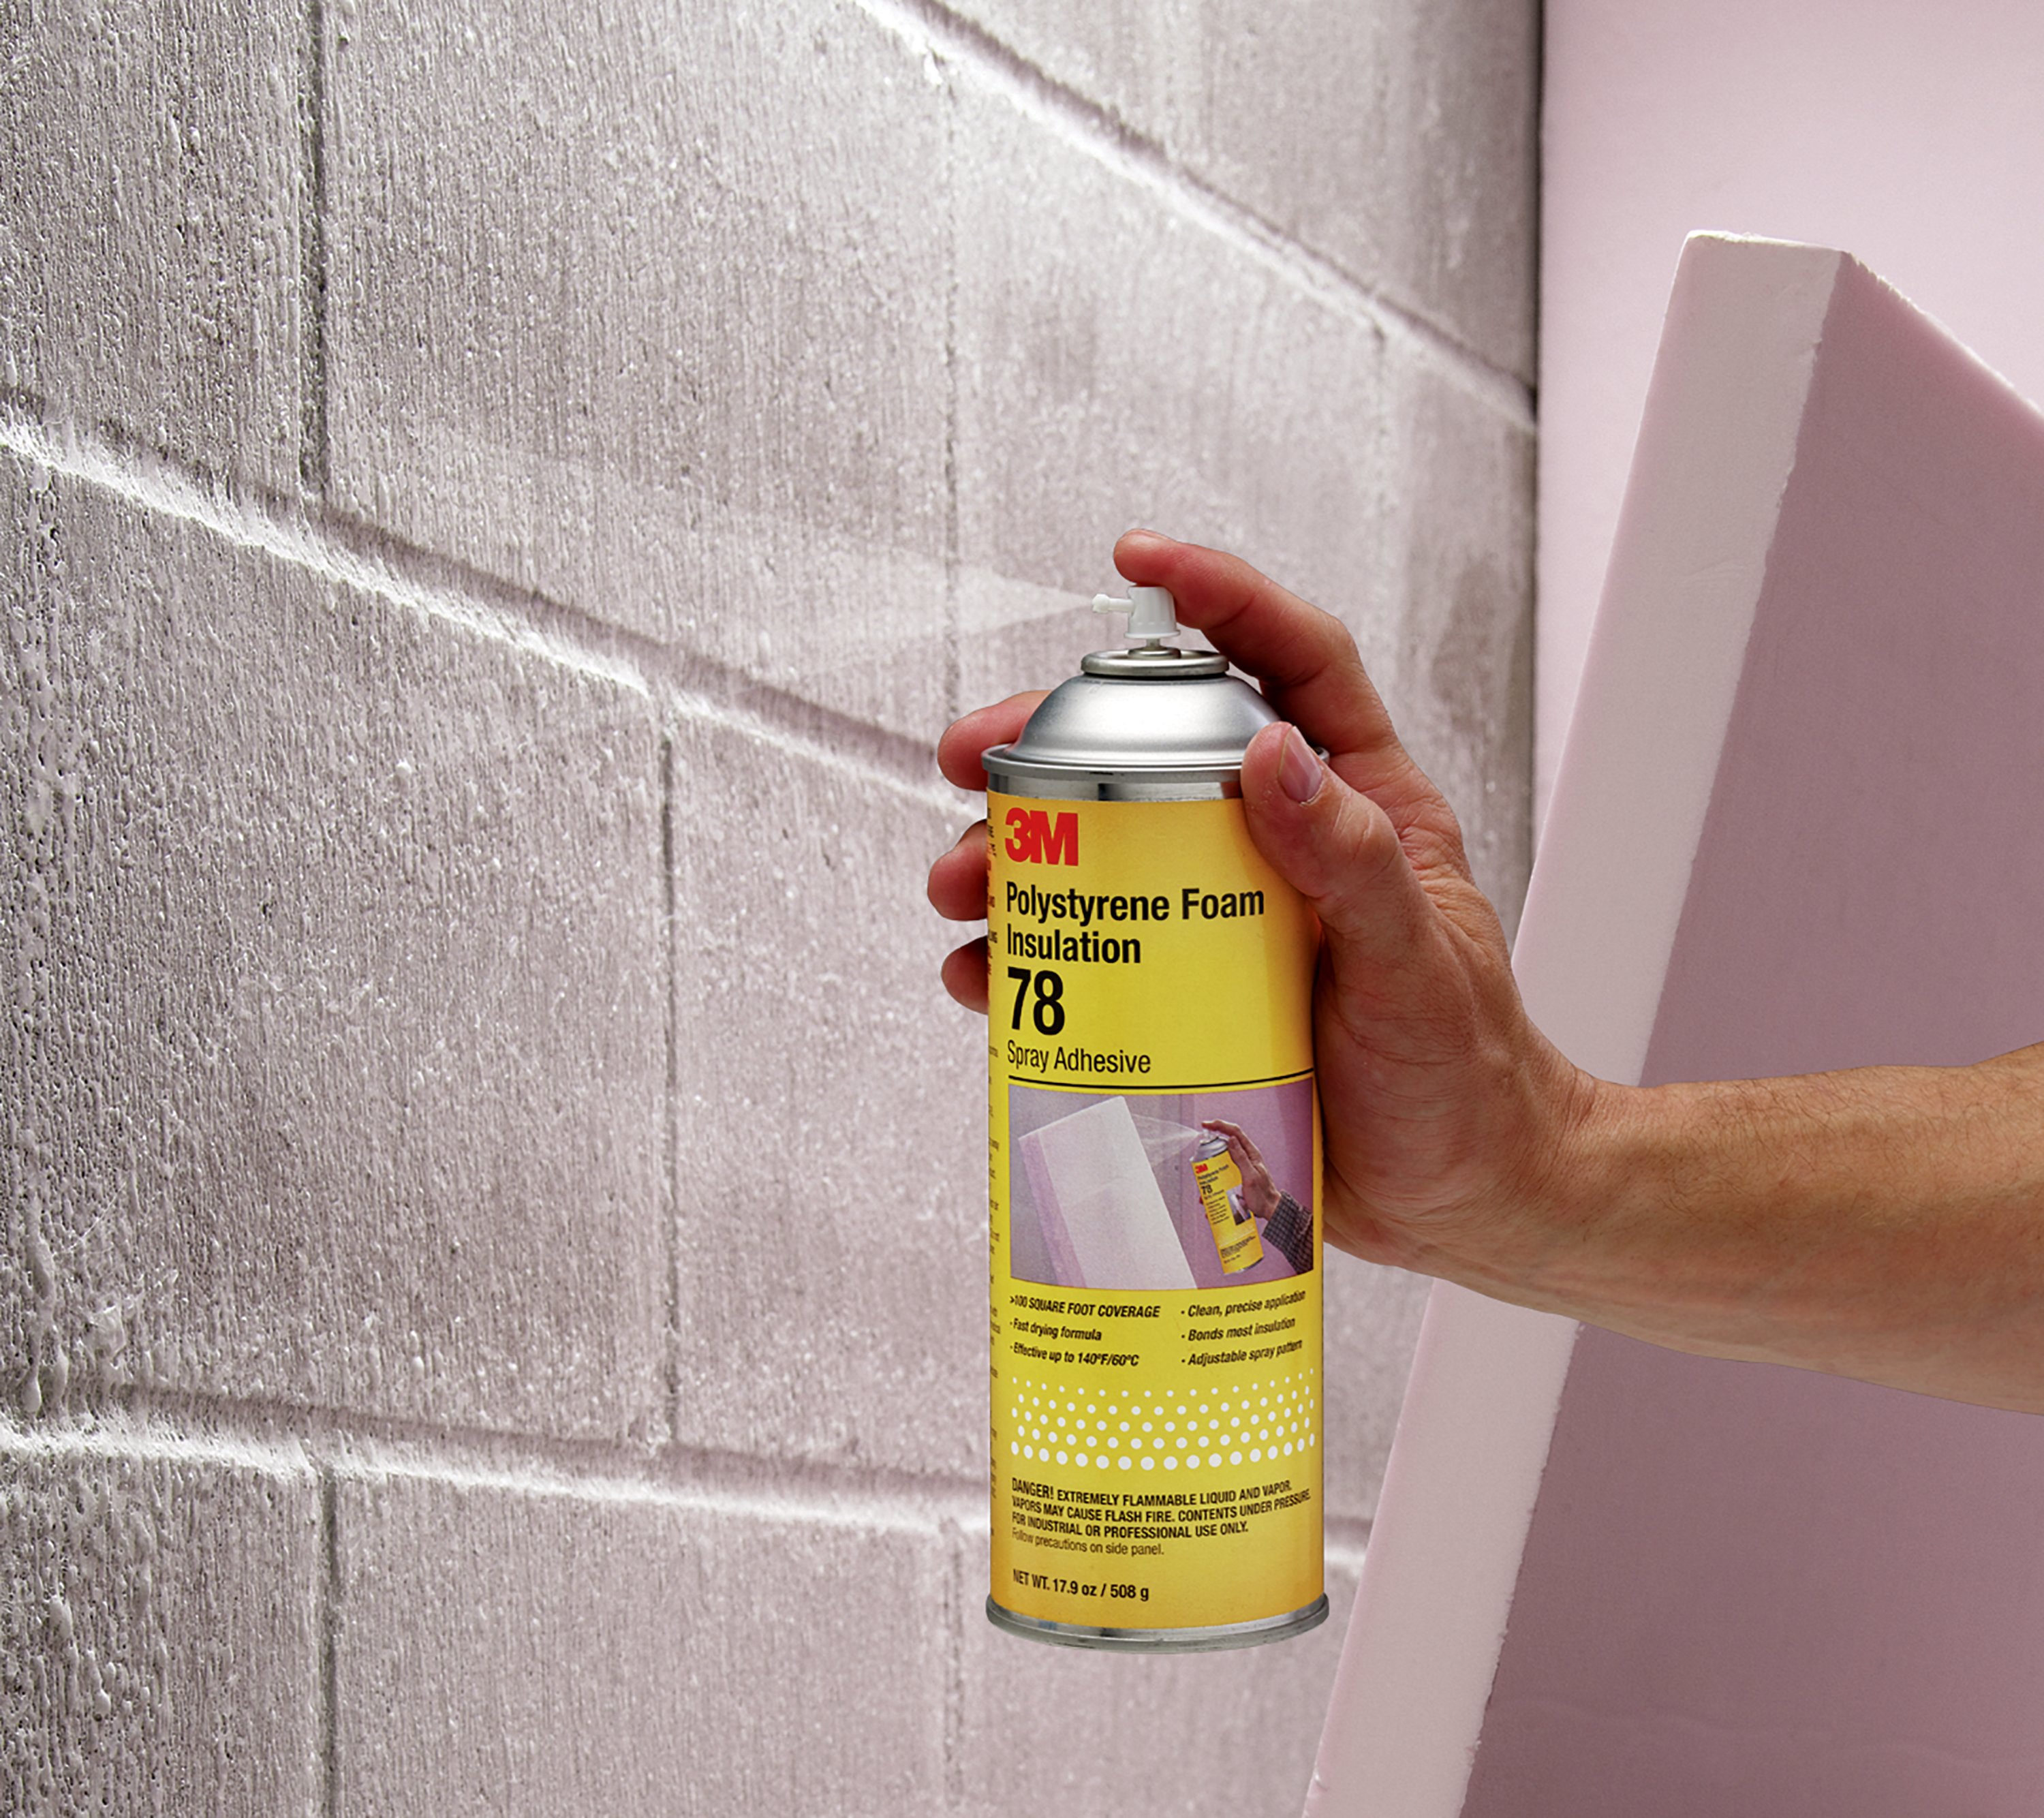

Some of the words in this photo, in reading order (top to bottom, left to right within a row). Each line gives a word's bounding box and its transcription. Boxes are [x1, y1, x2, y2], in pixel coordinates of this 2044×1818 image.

[1005, 807, 1079, 867] 3M
[1006, 880, 1170, 927] Polystyrene
[1181, 888, 1265, 921] Foam
[1007, 923, 1141, 964] Insulation
[1008, 966, 1065, 1036] 78
[1007, 1039, 1049, 1073] Spray
[1053, 1046, 1151, 1074] Adhesive
[1010, 1295, 1027, 1308] >100
[1029, 1297, 1066, 1314] SQUARE
[1068, 1302, 1096, 1316] FOOT
[1098, 1304, 1161, 1318] COVERAGE
[1188, 1304, 1222, 1317] Clean,
[1224, 1299, 1263, 1316] precise
[1264, 1290, 1306, 1311] application
[1013, 1318, 1029, 1332] Fast
[1030, 1322, 1059, 1340] drying
[1060, 1325, 1102, 1341] formula
[1188, 1328, 1224, 1342] Bonds
[1226, 1324, 1253, 1339] most
[1254, 1317, 1296, 1336] insulation
[1013, 1342, 1048, 1359] Effective
[1049, 1351, 1062, 1364] up
[1064, 1351, 1075, 1363] to
[1188, 1350, 1247, 1367] Adjustable
[1248, 1346, 1276, 1362] spray
[1275, 1340, 1303, 1357] pattern
[1012, 1477, 1054, 1499] DANGER!
[1057, 1489, 1119, 1506] EXTREMELY
[1123, 1493, 1197, 1507] FLAMMABLE
[1200, 1490, 1237, 1505] LIQUID
[1239, 1486, 1260, 1500] AND
[1262, 1479, 1292, 1496] VAPOR.
[1012, 1496, 1042, 1513] VAPORS
[1043, 1503, 1064, 1518] MAY
[1067, 1507, 1102, 1521] CAUSE
[1105, 1510, 1142, 1523] FLASH
[1146, 1511, 1175, 1523] FIRE.
[1178, 1506, 1237, 1522] CONTENTS
[1239, 1500, 1273, 1517] UNDER
[1012, 1511, 1026, 1526] FOR
[1027, 1515, 1083, 1535] INDUSTRIAL
[1085, 1524, 1100, 1537] OR
[1104, 1525, 1192, 1539] PROFESSIONAL
[1195, 1524, 1217, 1537] USE
[1220, 1520, 1249, 1535] ONLY.
[1012, 1527, 1034, 1543] Follow
[1034, 1534, 1087, 1552] precautions
[1089, 1543, 1102, 1553] on
[1105, 1542, 1128, 1554] side
[1132, 1543, 1165, 1557] panel.
[1013, 1568, 1029, 1586] NET
[1031, 1573, 1050, 1590] WT.
[1053, 1578, 1079, 1595] 17.9
[1081, 1584, 1097, 1597] oz
[1100, 1583, 1106, 1597] /
[1110, 1584, 1136, 1599] 508
[1141, 1587, 1149, 1601] g
